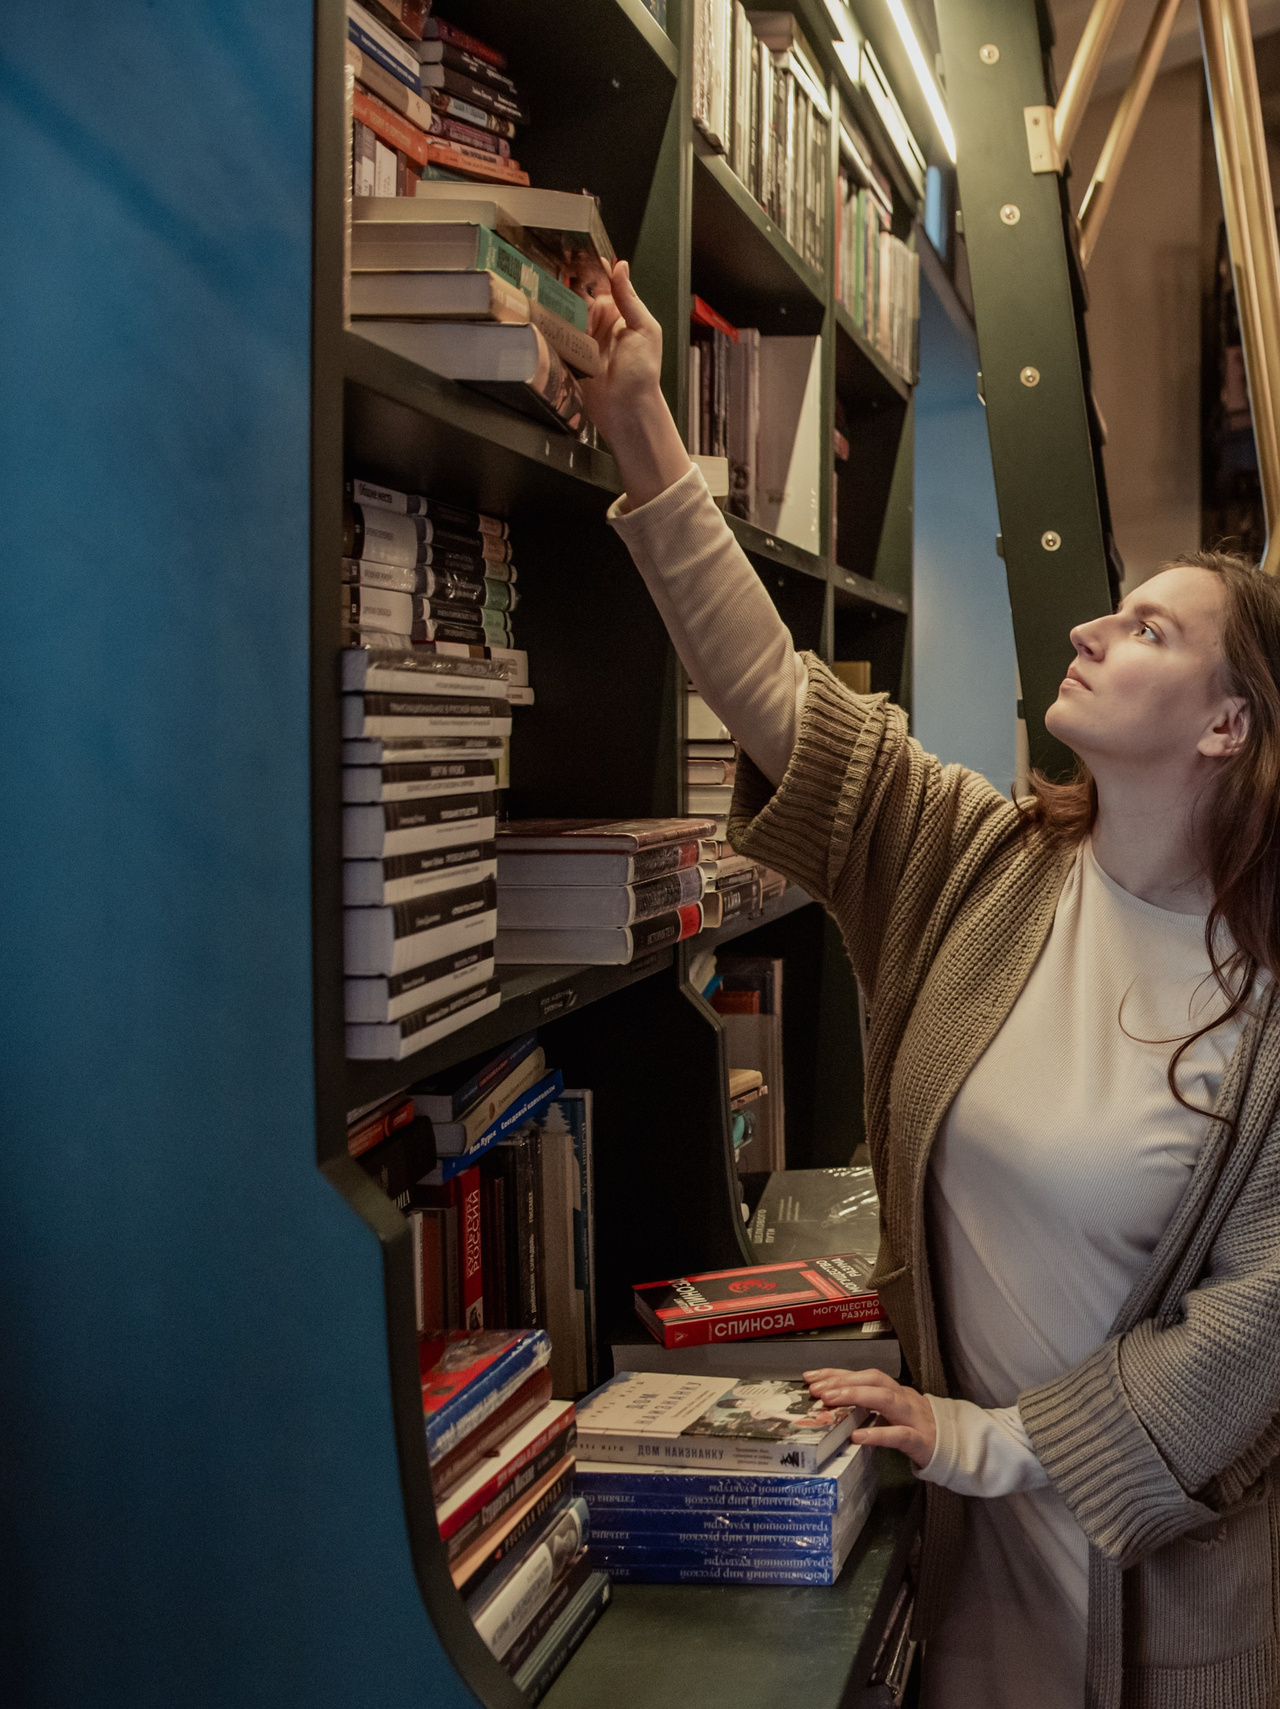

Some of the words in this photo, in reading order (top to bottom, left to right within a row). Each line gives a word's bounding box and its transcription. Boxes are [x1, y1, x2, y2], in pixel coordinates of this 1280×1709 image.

[466, 1191, 475, 1277] КУЛЬТУРА
[471, 1188, 480, 1272] РОССИИ
[765, 1228, 776, 1244] ПУТИ
[831, 1257, 862, 1278] РАЗУМА
[816, 1259, 863, 1293] МОГУЩЕСТВО
[812, 1298, 880, 1317] МОГУЩЕСТВО
[841, 1308, 880, 1320] РАЗУМА
[715, 1312, 795, 1336] СПИНОЗА
[634, 1381, 702, 1425] НАИЗНАНКУ
[637, 1444, 660, 1457] ДОМ
[664, 1446, 724, 1460] НАИЗНАНКУ
[708, 1480, 757, 1495] культуры
[597, 1494, 635, 1504] татьяна
[684, 1494, 726, 1508] русской
[727, 1494, 749, 1507] мир
[750, 1497, 836, 1510] феноменальный
[703, 1519, 751, 1532] культуры
[752, 1520, 830, 1533] традиционной
[591, 1531, 630, 1540] татьяна
[679, 1530, 720, 1544] русской
[722, 1532, 744, 1545] мир
[745, 1534, 830, 1548] феноменальный
[703, 1556, 752, 1568] культуры
[753, 1556, 830, 1569] традиционной
[680, 1568, 721, 1580] русской
[723, 1567, 745, 1579] мир
[746, 1569, 831, 1583] феноменальный
